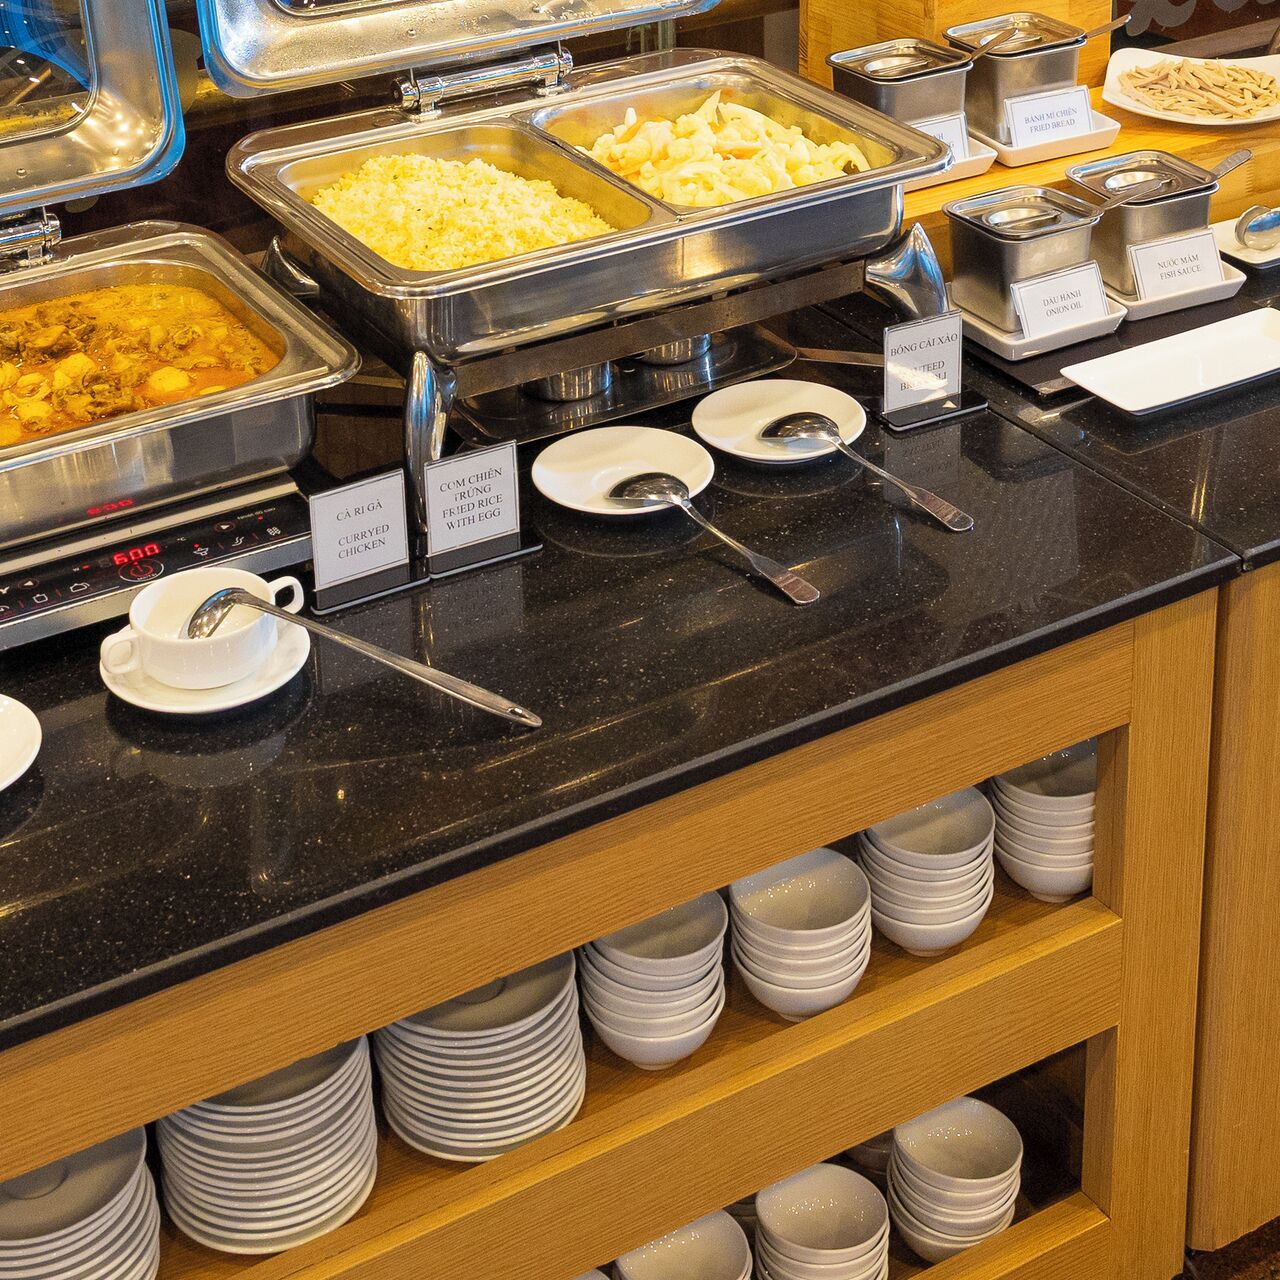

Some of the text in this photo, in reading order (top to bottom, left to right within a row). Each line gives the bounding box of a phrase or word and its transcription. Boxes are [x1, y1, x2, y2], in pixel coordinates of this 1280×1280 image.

[1030, 118, 1076, 134] FRIED BREAD
[1160, 265, 1202, 281] FISH SAUCE
[1045, 300, 1083, 318] ONION OIL
[354, 505, 365, 516] RI
[442, 493, 504, 519] FRIED RICE
[446, 507, 501, 531] WITH EGG
[338, 524, 390, 547] CURRYED
[112, 542, 161, 566] 600
[338, 537, 387, 559] CHICKEN
